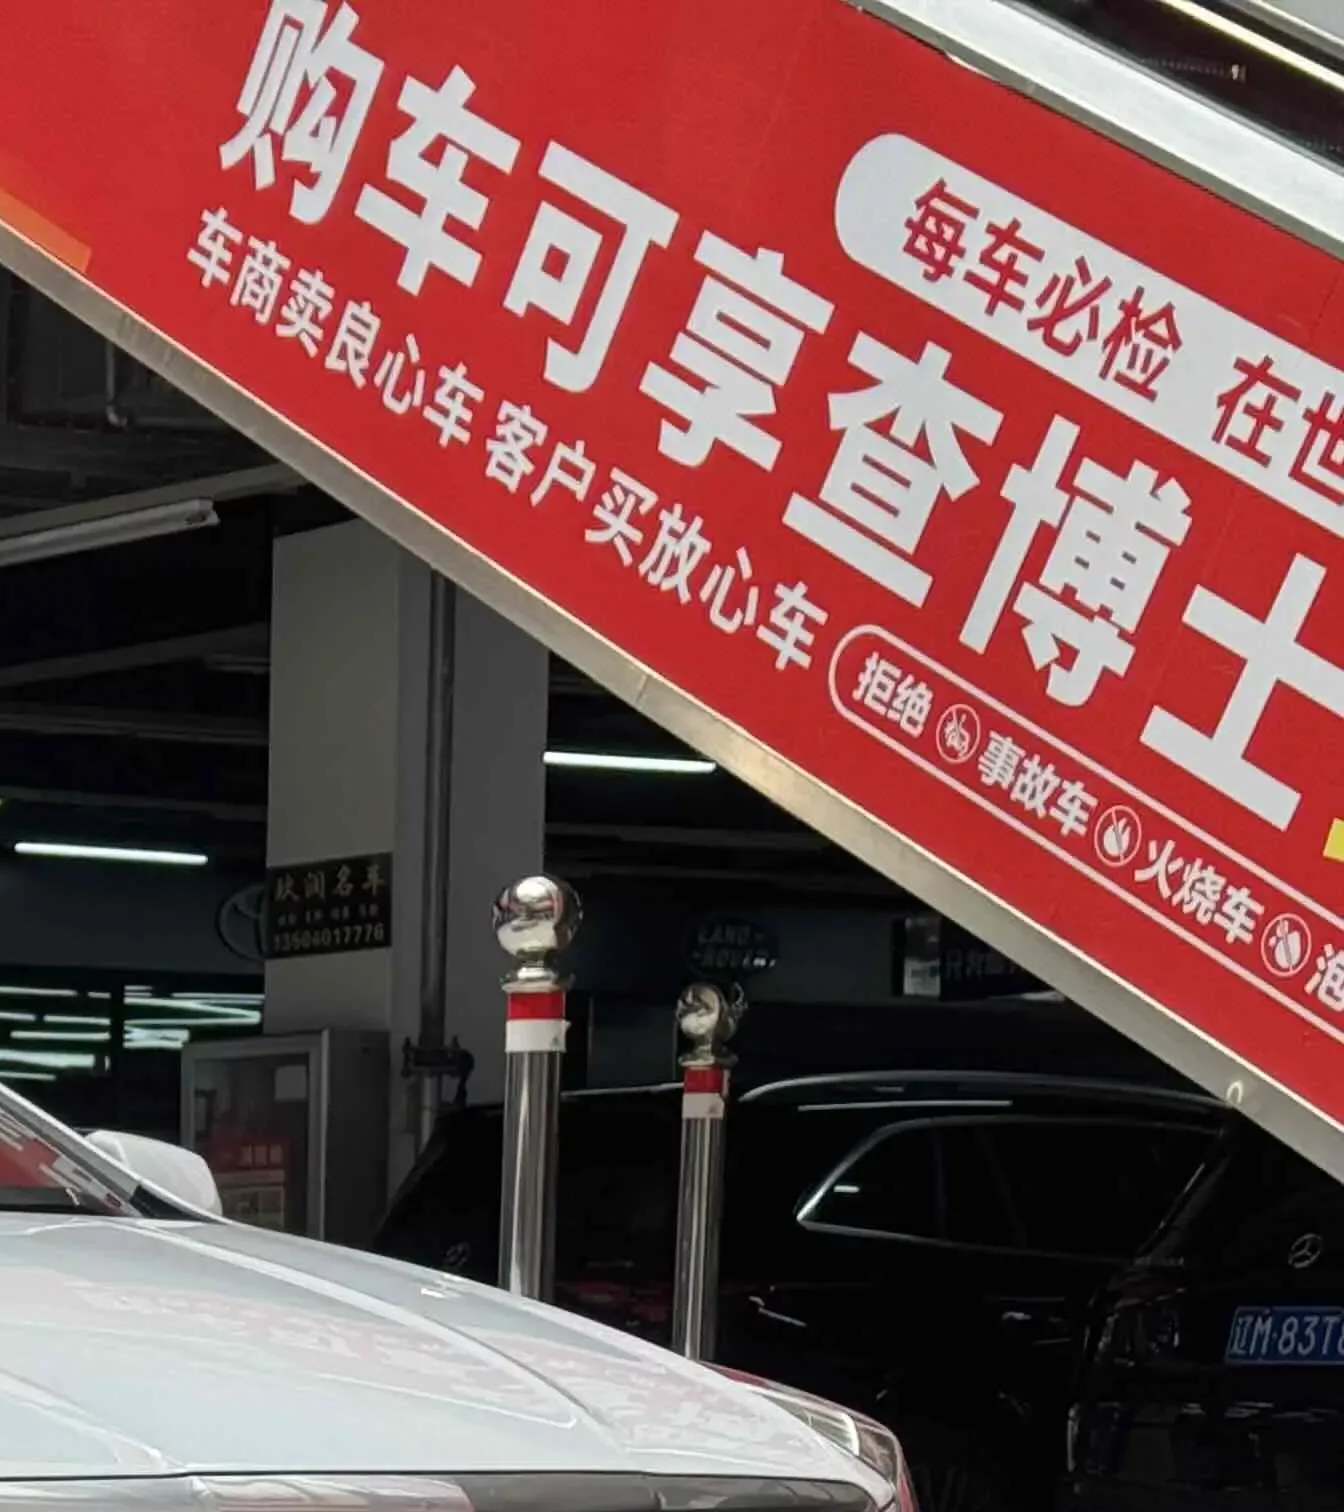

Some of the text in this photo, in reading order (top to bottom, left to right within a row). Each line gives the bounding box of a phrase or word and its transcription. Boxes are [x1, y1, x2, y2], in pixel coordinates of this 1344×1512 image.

[219, 0, 1344, 832] 购车可享查博士
[903, 178, 1183, 402] 每车必检
[186, 207, 829, 671] 车商卖良心车 客户买放心车
[851, 651, 934, 738] 拒绝
[977, 730, 1098, 837] 事故车
[1135, 839, 1265, 945] 火烧车
[1229, 1314, 1344, 1356] 辽M·83T
